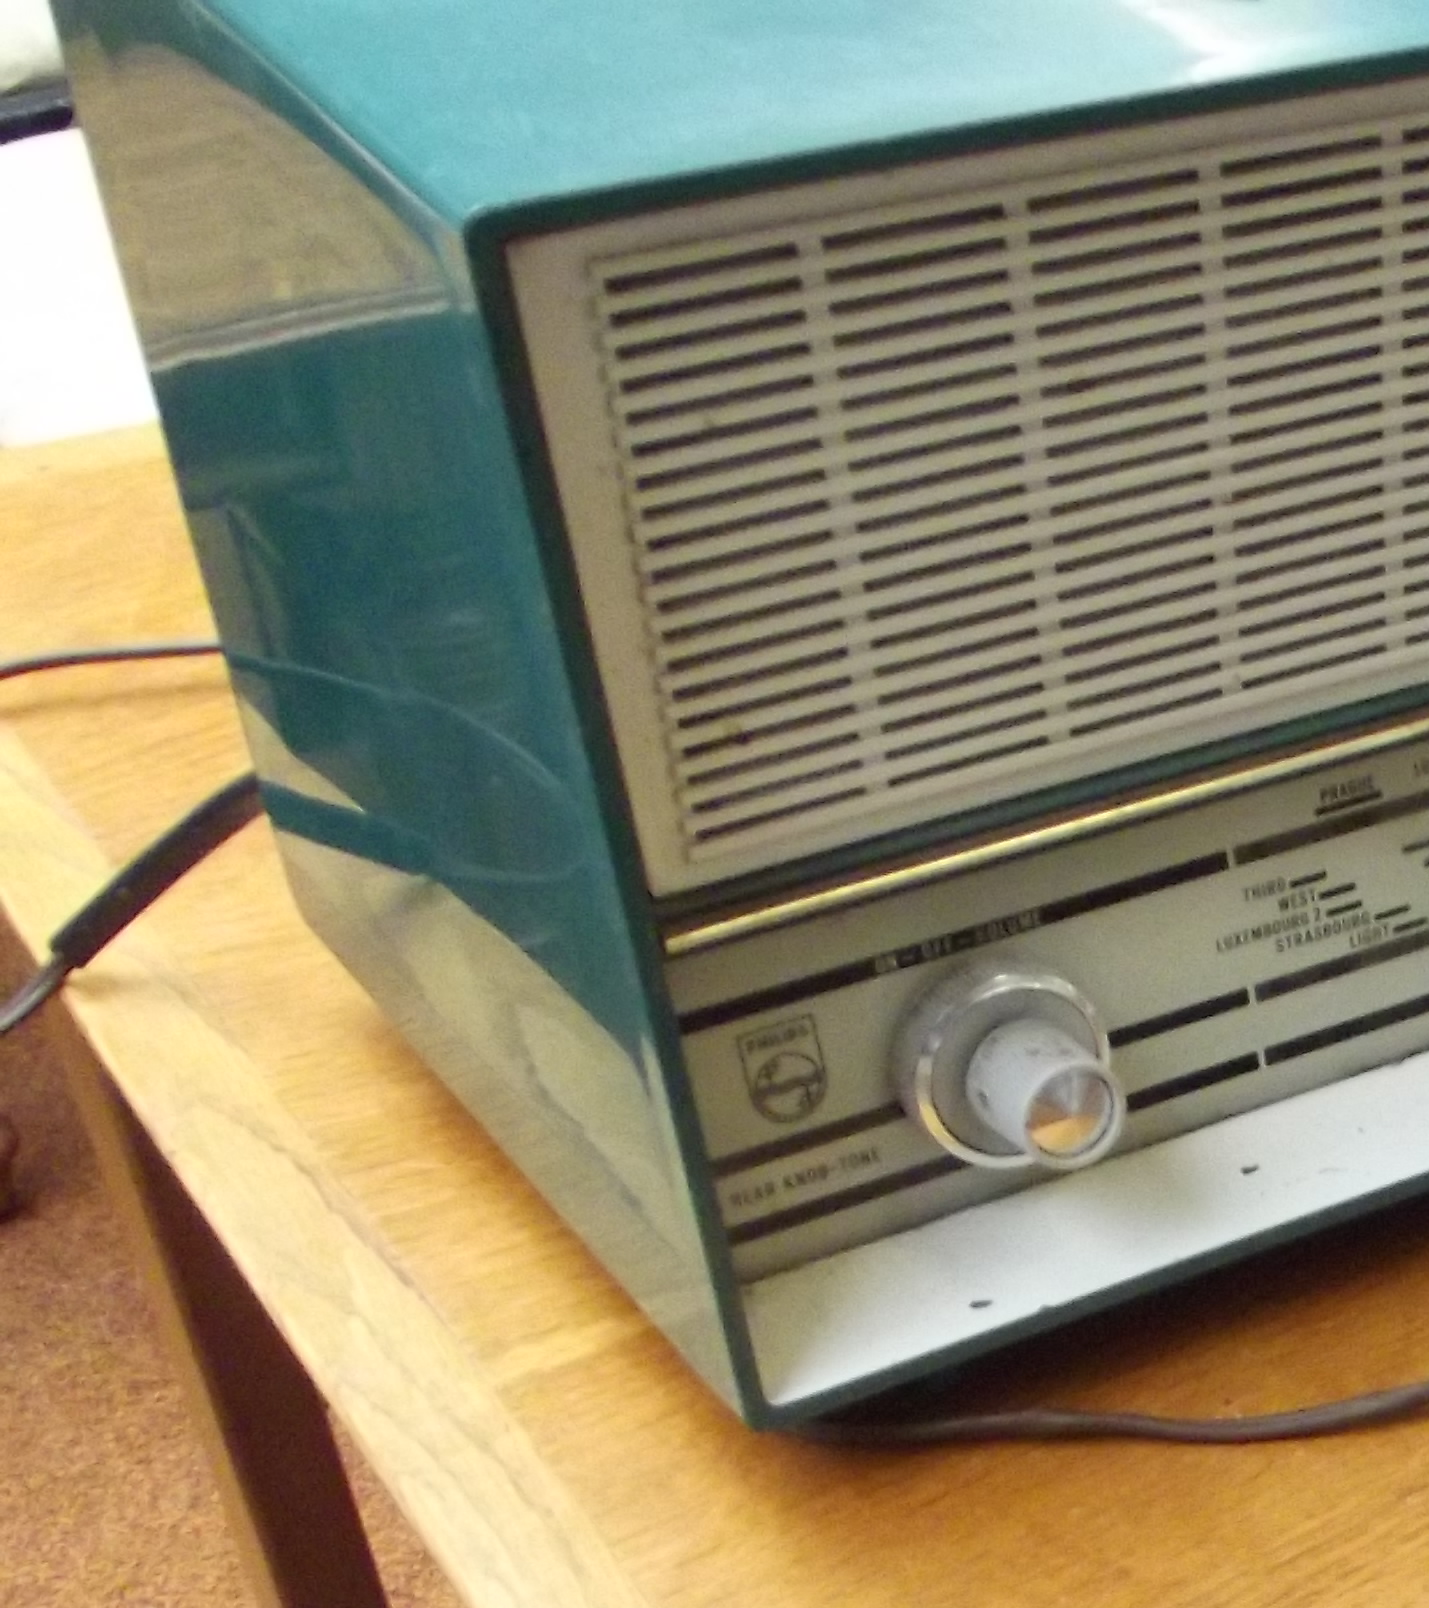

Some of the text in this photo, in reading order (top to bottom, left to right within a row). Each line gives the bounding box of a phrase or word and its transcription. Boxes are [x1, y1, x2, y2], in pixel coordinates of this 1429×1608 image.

[1319, 774, 1374, 801] PRAGUE
[1244, 877, 1287, 902] THIRD
[1277, 887, 1317, 911] WEST
[1216, 911, 1310, 952] LUXEMBOURG
[1275, 909, 1371, 953] STRASBOURG
[1348, 923, 1389, 949] LIGHT
